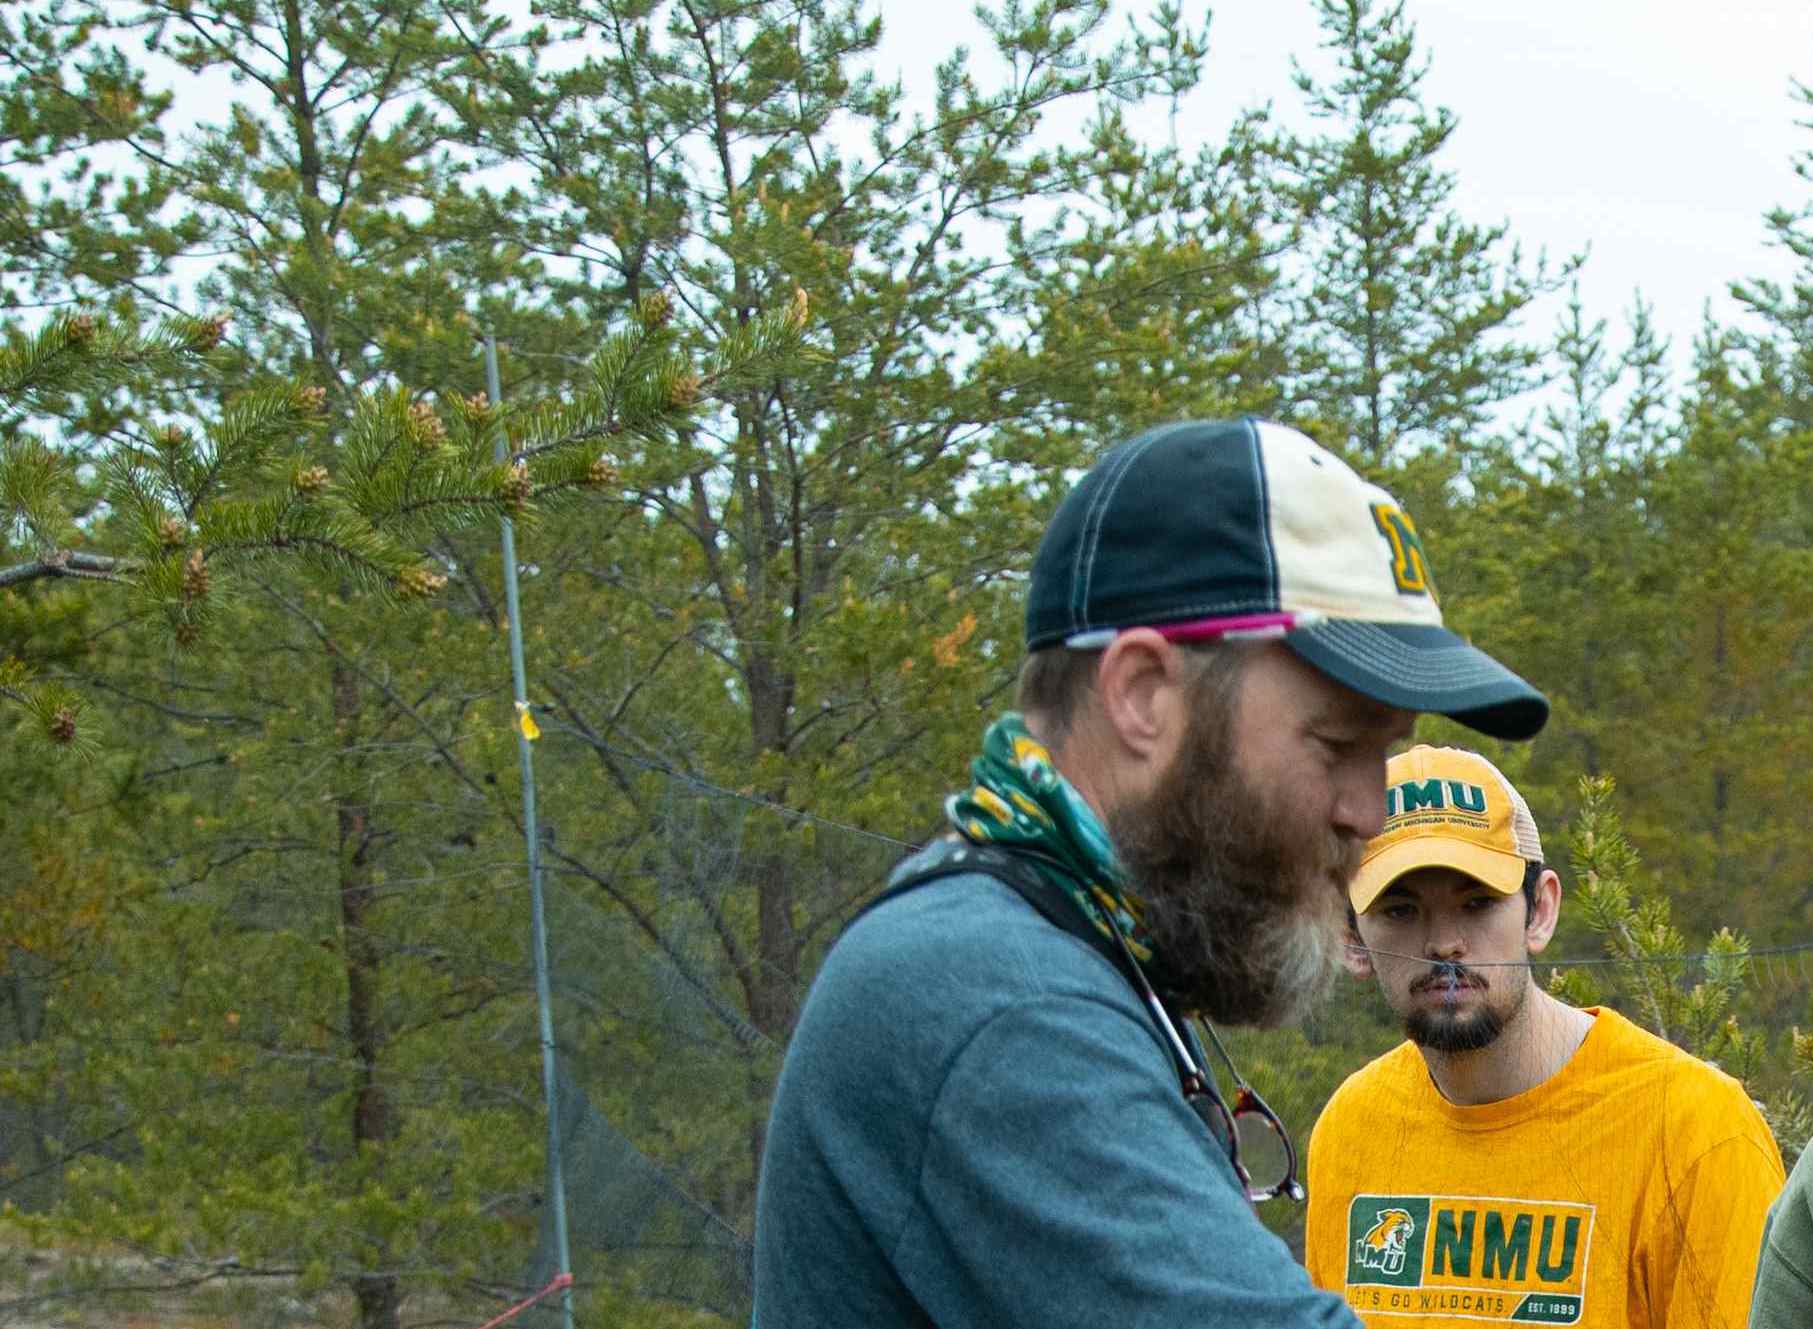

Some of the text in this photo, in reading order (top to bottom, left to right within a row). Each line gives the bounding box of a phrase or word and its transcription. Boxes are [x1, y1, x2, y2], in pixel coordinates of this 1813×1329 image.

[1354, 1239, 1407, 1275] NMU
[1432, 1208, 1583, 1283] NMU
[1391, 1293, 1411, 1309] GO
[1420, 1293, 1504, 1313] WILDCATS
